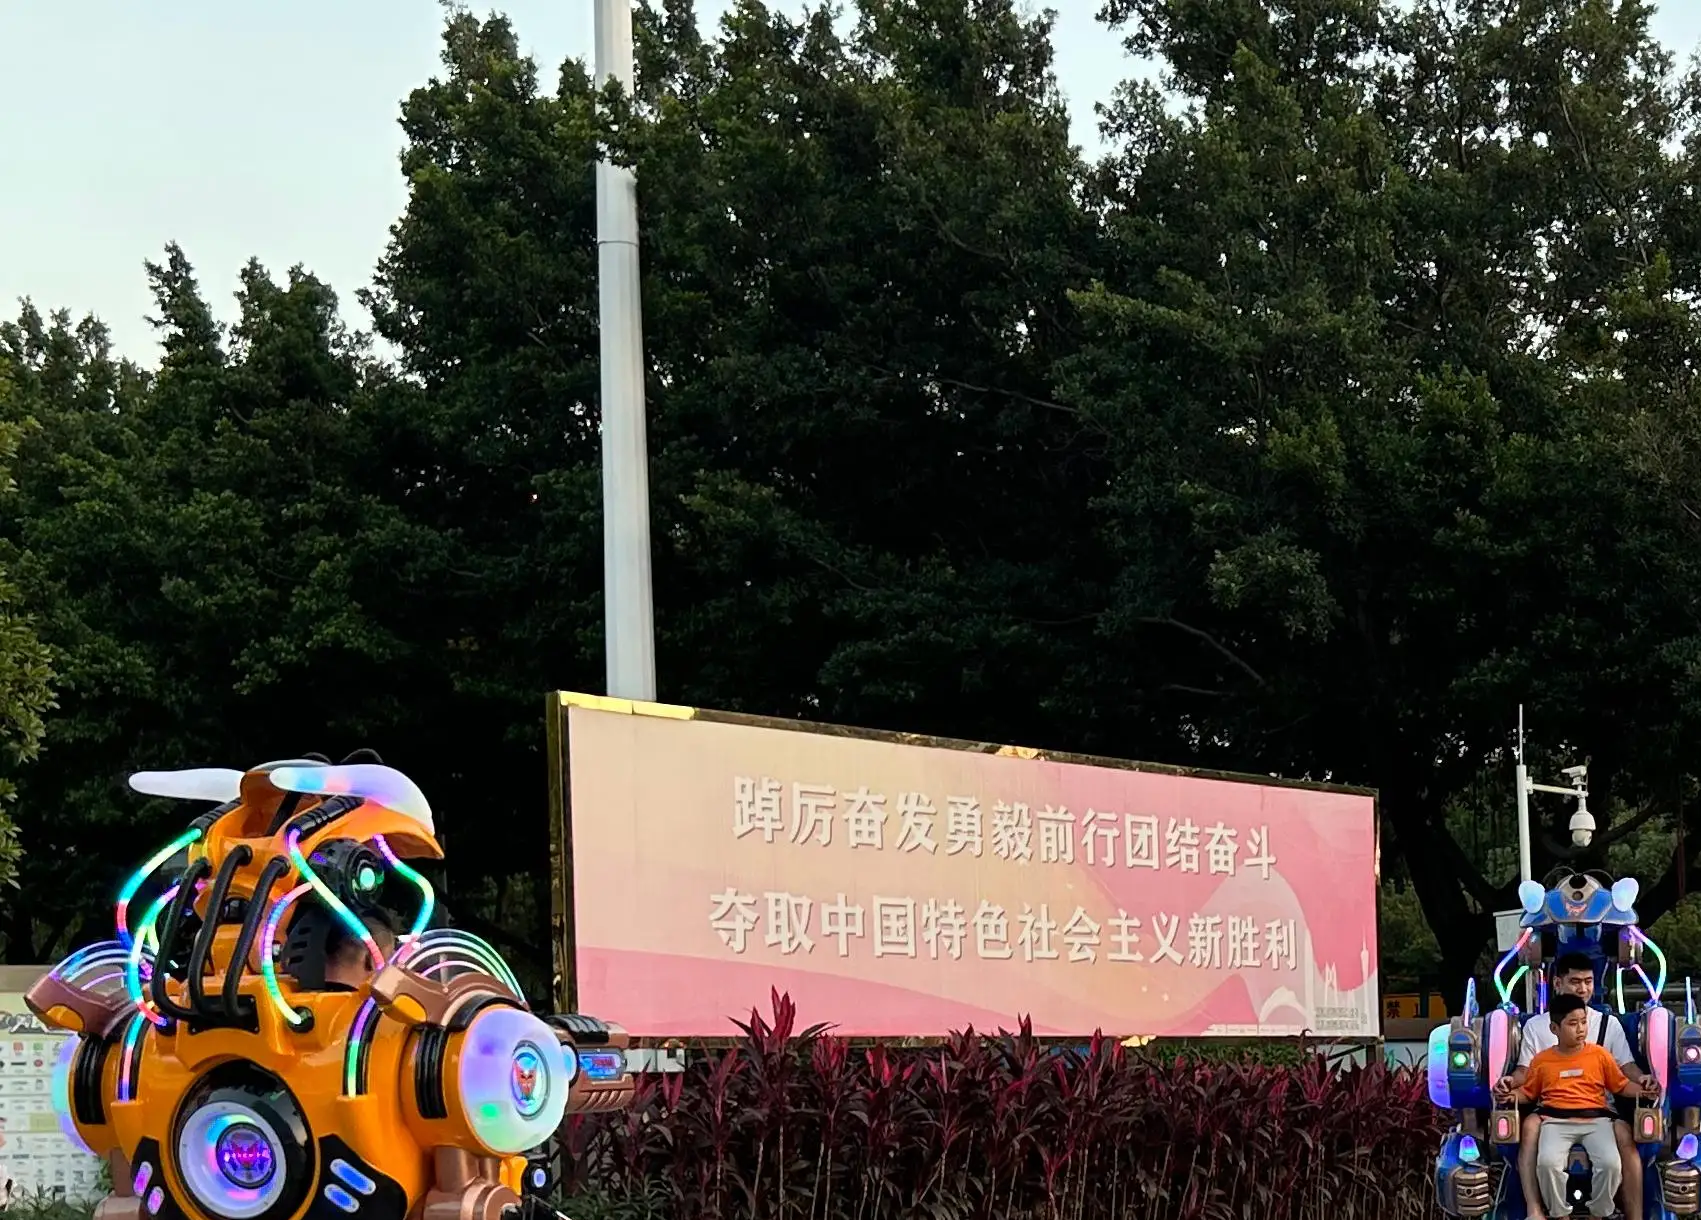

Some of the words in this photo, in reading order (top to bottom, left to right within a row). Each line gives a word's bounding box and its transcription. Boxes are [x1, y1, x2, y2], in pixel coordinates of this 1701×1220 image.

[733, 776, 1277, 879] 踔厉奋发勇毅前行团结奋斗
[708, 886, 1298, 970] 夺取中国特色社会主义新胜利
